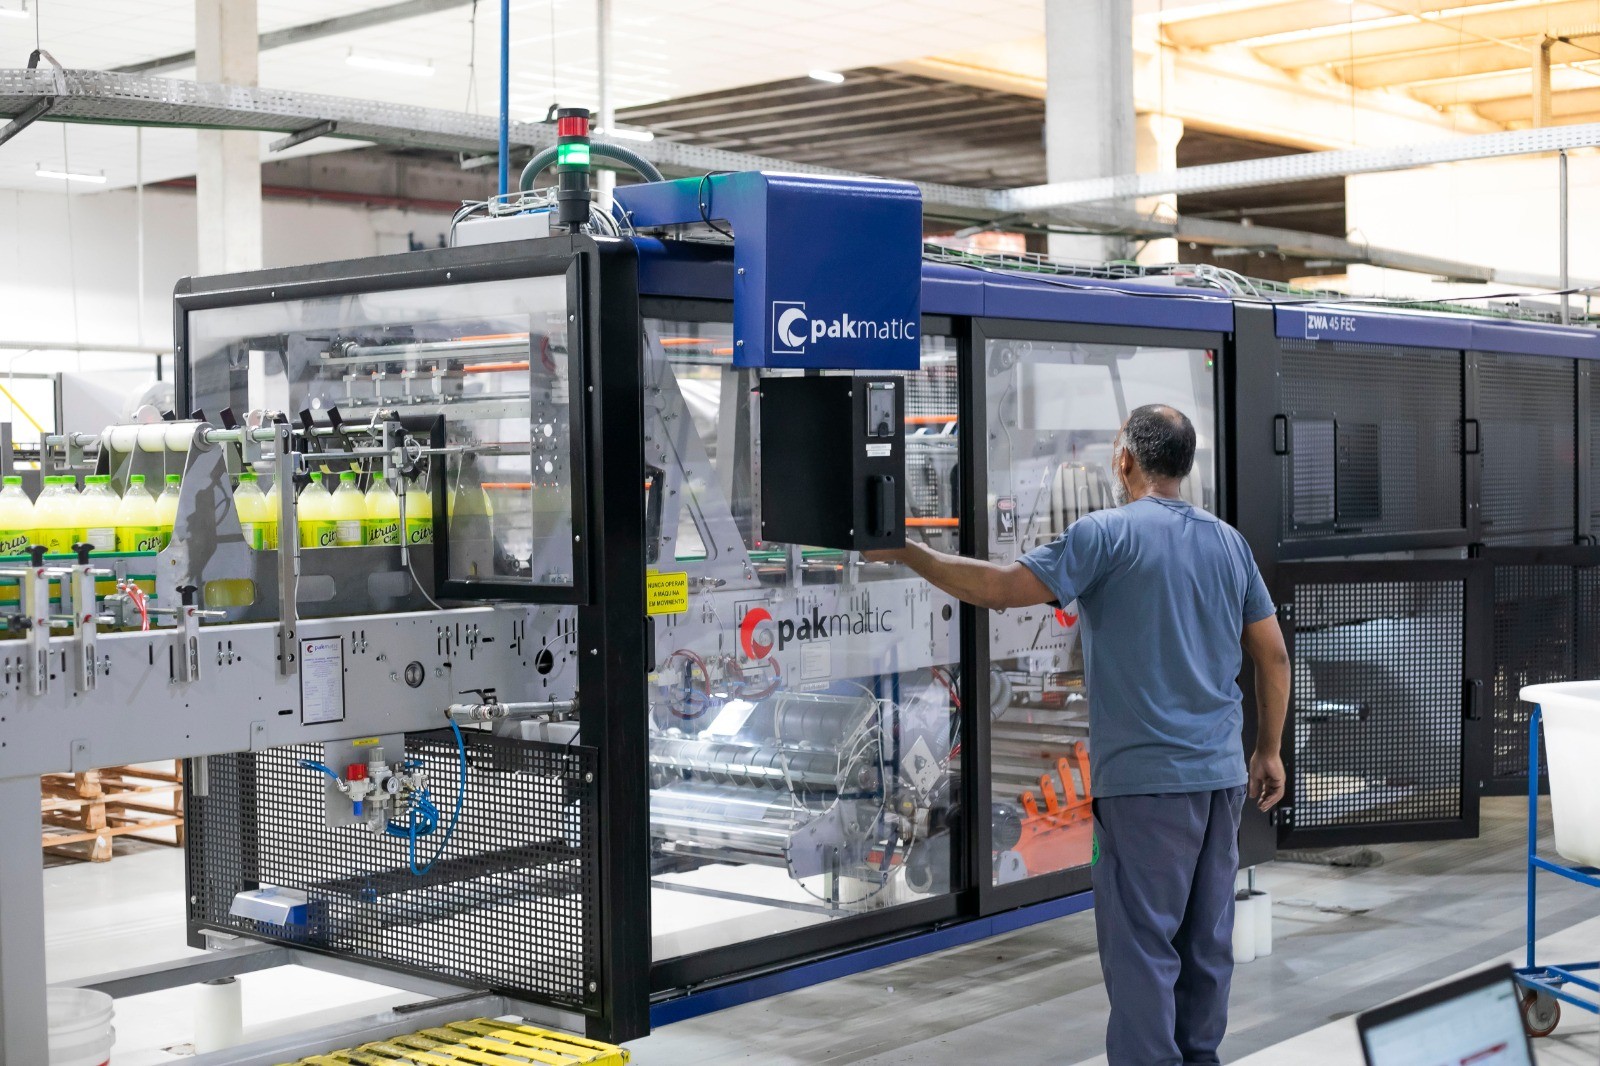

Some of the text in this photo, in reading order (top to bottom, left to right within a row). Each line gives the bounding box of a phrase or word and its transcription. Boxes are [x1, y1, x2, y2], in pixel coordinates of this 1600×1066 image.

[811, 313, 915, 343] pakmatic
[1308, 315, 1356, 332] ZWA 45 FEC
[369, 523, 398, 542] itrus
[411, 527, 433, 543] Citr
[0, 535, 28, 552] trus
[778, 606, 892, 651] pakmatic
